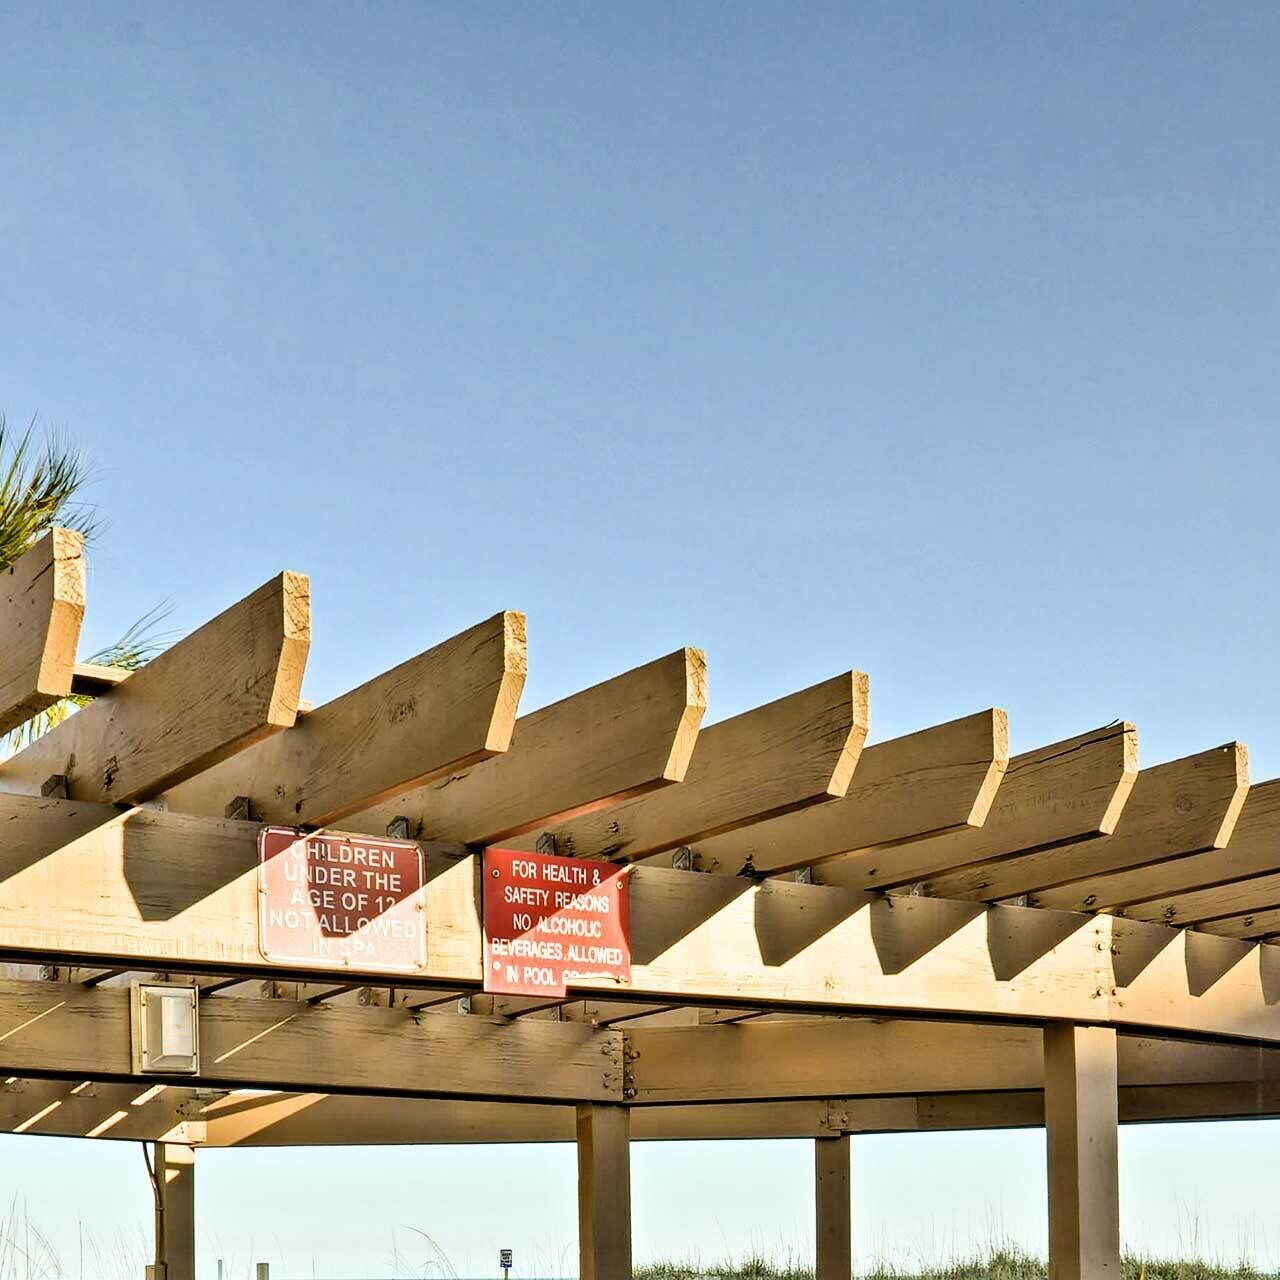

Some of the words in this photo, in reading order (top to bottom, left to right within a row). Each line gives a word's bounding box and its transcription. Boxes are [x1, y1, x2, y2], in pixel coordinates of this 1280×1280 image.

[291, 840, 395, 868] CHILDREN
[284, 862, 357, 887] UNDER
[363, 871, 402, 892] THE
[512, 860, 537, 879] FOR
[542, 864, 587, 885] HEALTH
[592, 869, 600, 886] &
[291, 888, 335, 909] AGE
[341, 893, 368, 911] OF
[504, 885, 550, 906] SAFETY
[555, 892, 609, 914] REASONS
[270, 909, 313, 929] NOT
[320, 914, 417, 938] ALLOWED
[513, 913, 532, 931] NO
[537, 916, 602, 938] ALCOHOLIC
[339, 939, 378, 958] SPA
[491, 938, 563, 960] BEVERAGES
[568, 946, 623, 965] ALLOWED
[506, 965, 518, 983] IN
[524, 966, 557, 986] POOL
